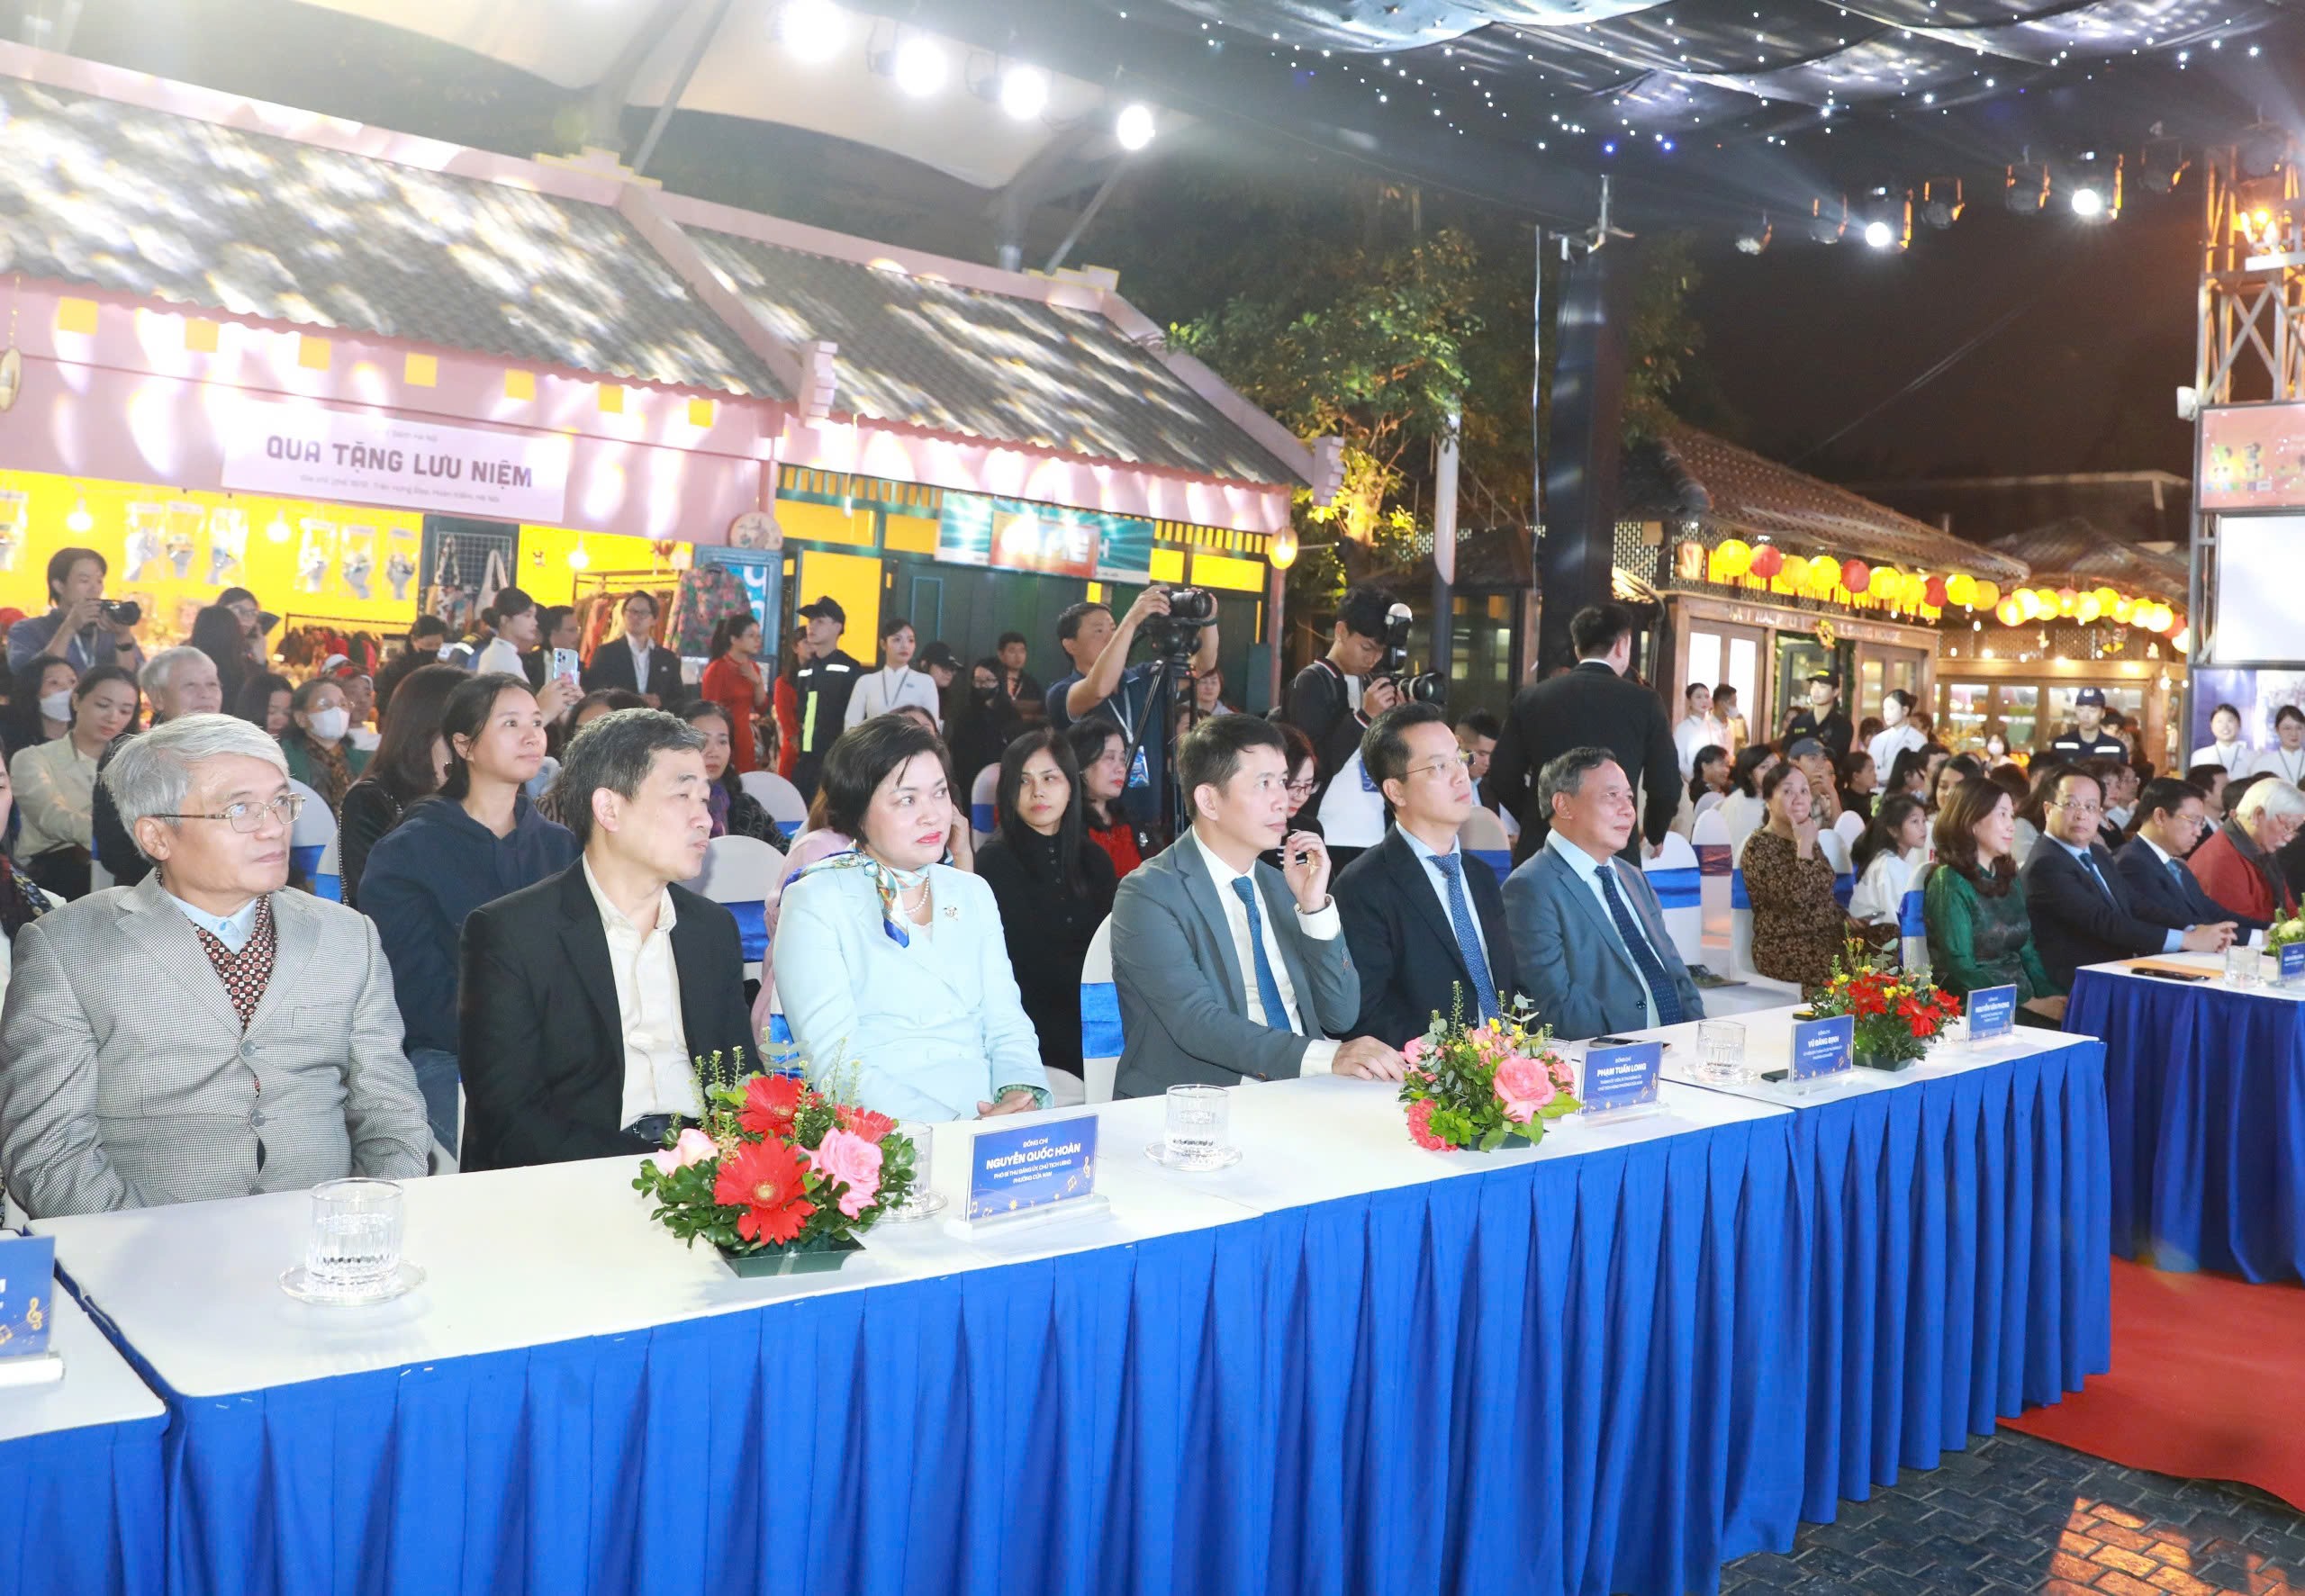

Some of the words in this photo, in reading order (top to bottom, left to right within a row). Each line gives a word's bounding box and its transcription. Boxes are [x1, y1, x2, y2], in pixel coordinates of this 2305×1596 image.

[332, 440, 403, 473] TẶNG
[471, 458, 532, 490] NIỆM
[1632, 1062, 1647, 1072] LONG
[986, 1150, 1026, 1170] NGUYỄN
[1026, 1146, 1054, 1162] QUỐC
[1054, 1141, 1081, 1158] HOÀN
